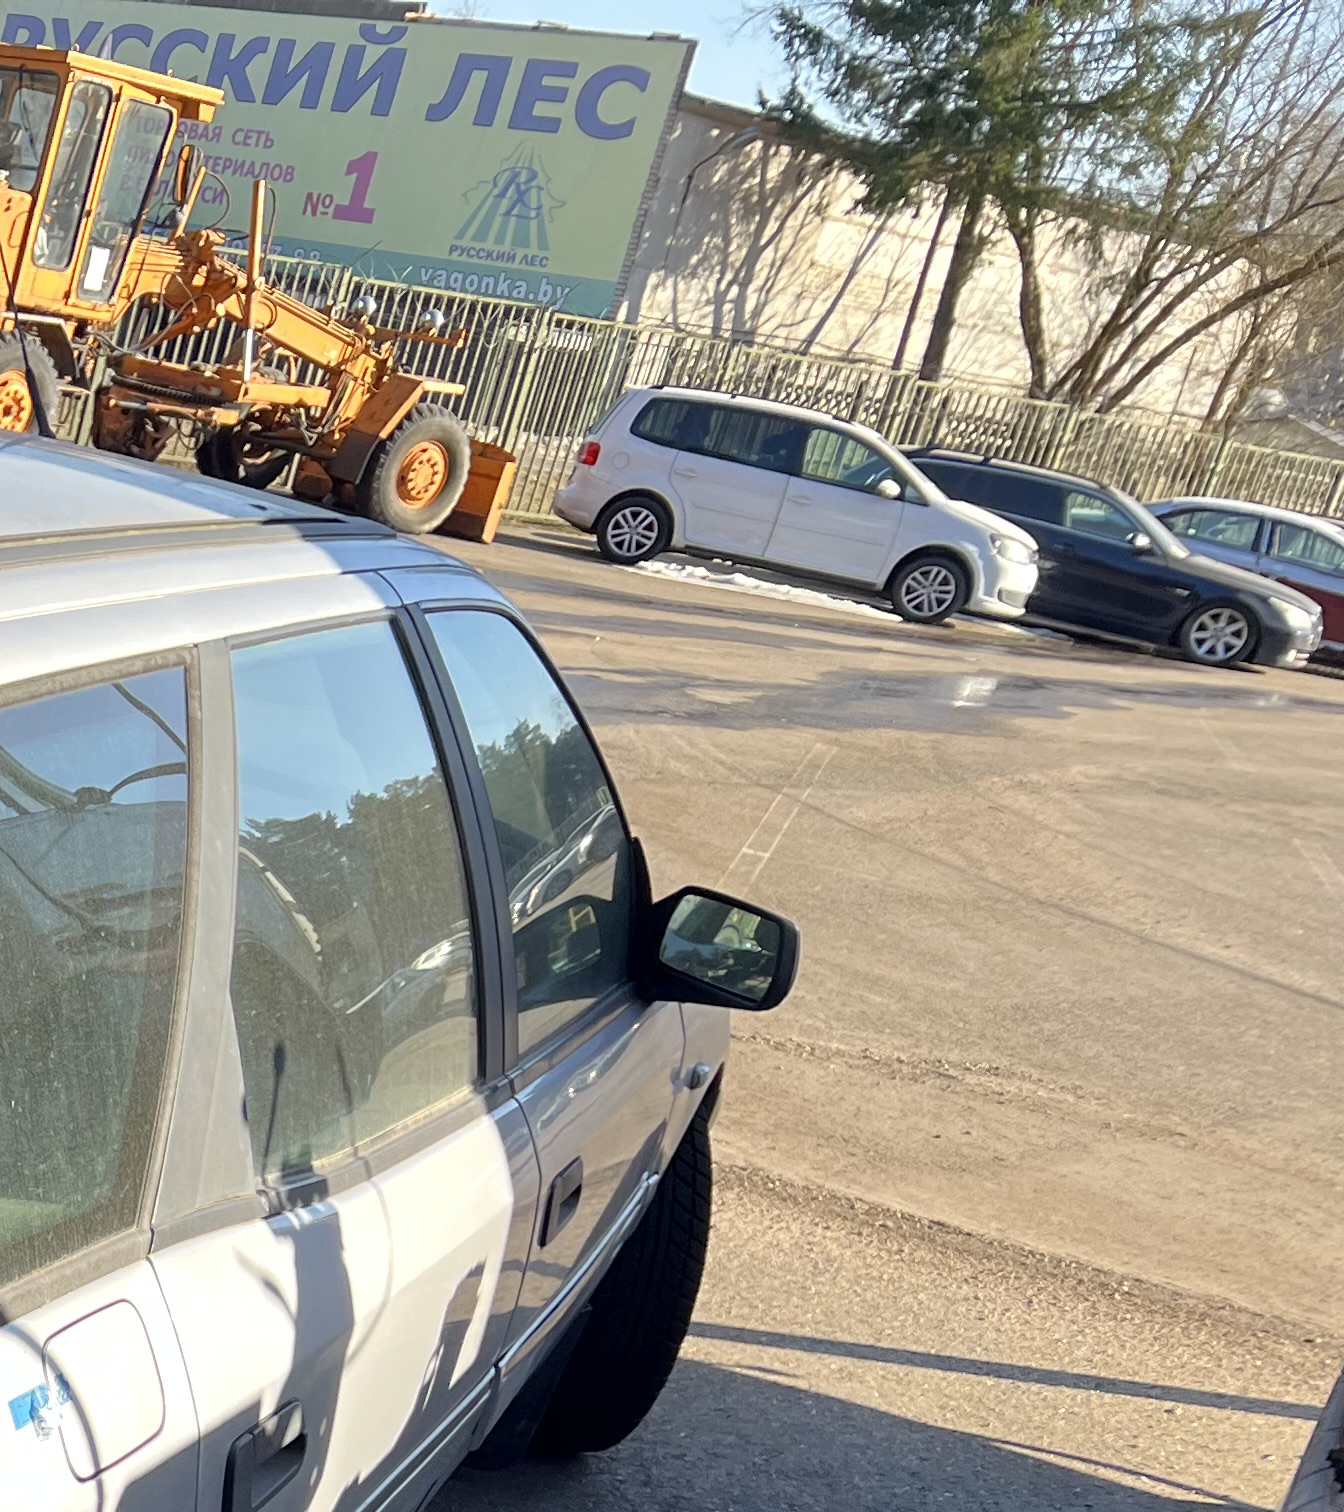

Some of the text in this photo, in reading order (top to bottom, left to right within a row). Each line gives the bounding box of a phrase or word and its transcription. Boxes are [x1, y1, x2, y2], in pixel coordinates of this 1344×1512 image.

[425, 53, 651, 140] ЛЕС
[135, 115, 276, 150] ТОРОВАЯ СЕТЬ
[448, 243, 550, 268] РУССКИЙ ЛЕС
